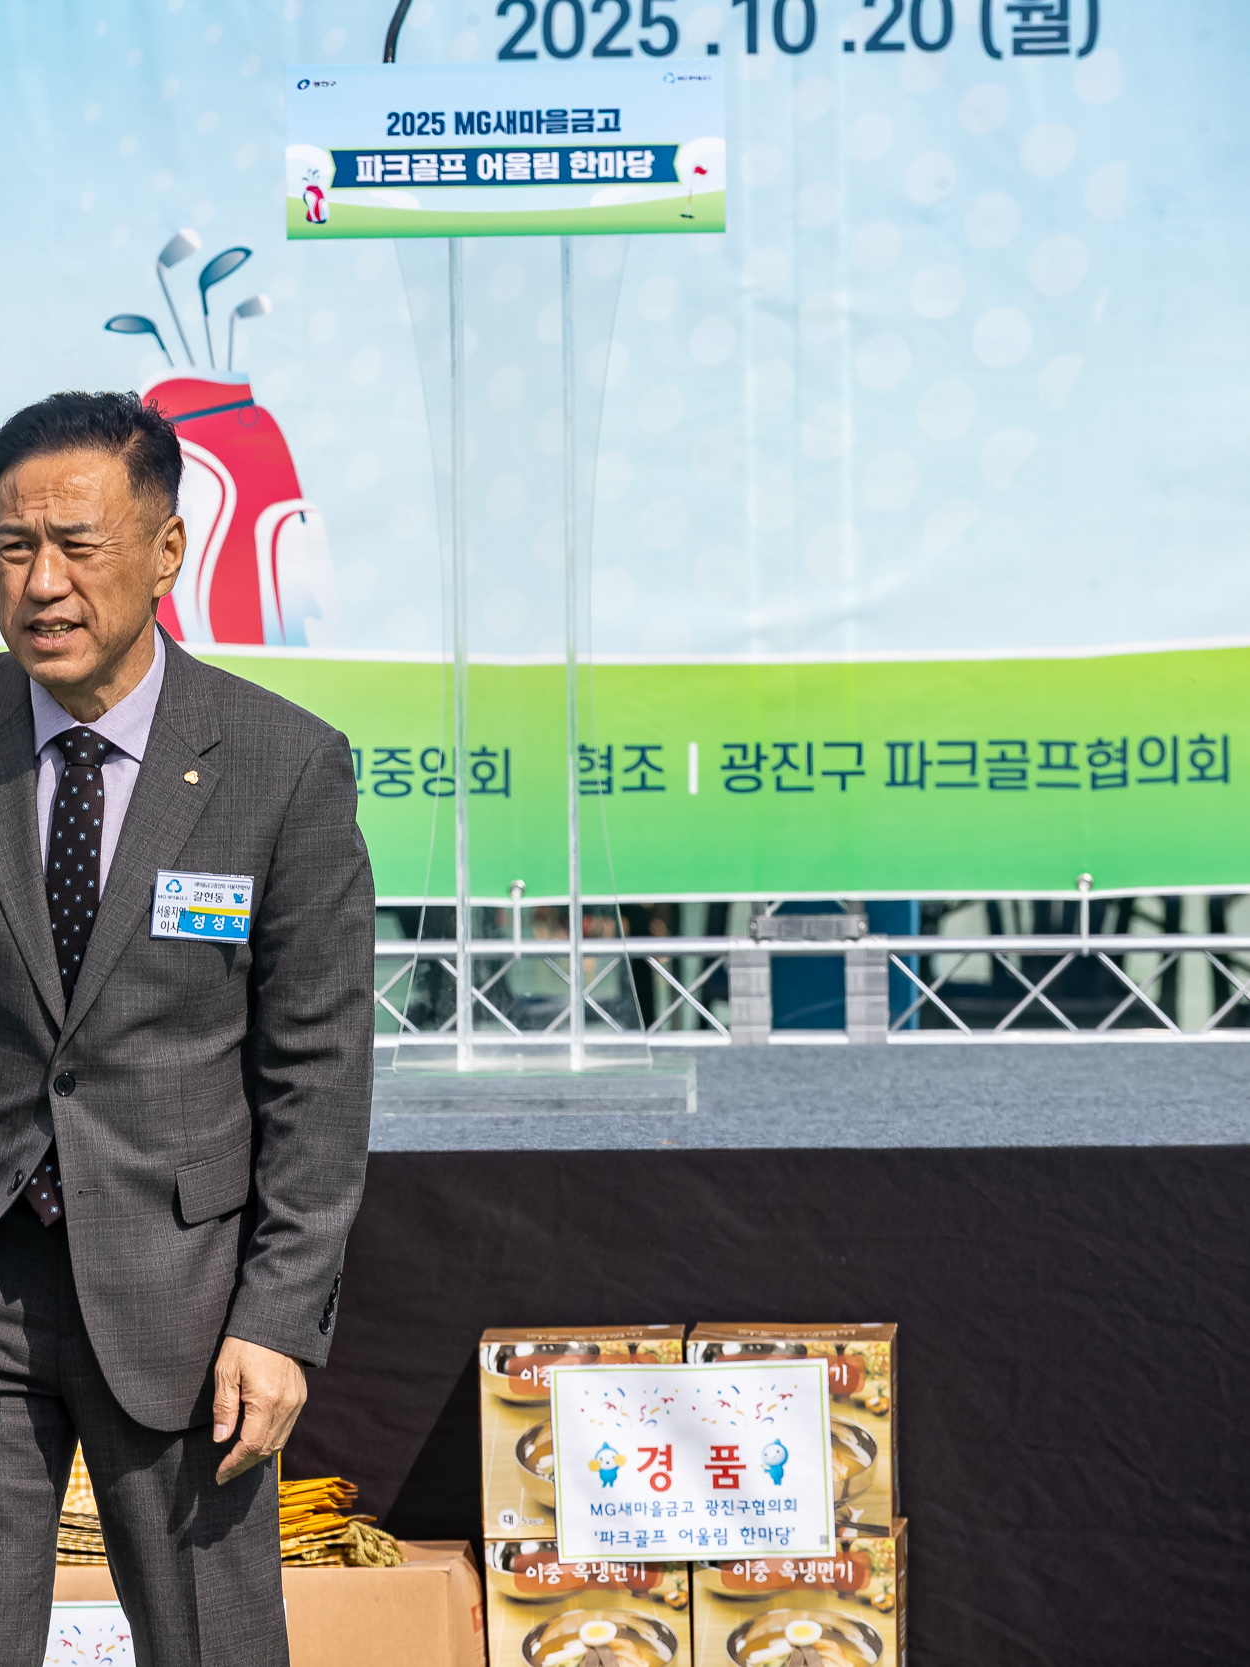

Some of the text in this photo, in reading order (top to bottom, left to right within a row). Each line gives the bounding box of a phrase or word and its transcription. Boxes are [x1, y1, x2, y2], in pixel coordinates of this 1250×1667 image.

[496, 0, 679, 60] 2025
[387, 108, 621, 136] 2025 MG새마을금고
[355, 150, 655, 182] 파크골프 어울림 한마당
[577, 733, 1230, 796] 협조 광진구 파크골프협의회
[156, 905, 187, 919] 서울지역
[160, 920, 181, 934] 이사
[590, 1498, 798, 1518] MG새마을금고 광진구협의회
[678, 1527, 729, 1546] 어울림
[525, 1561, 563, 1585] 이중
[732, 1559, 854, 1584] 이중 옥냉면기
